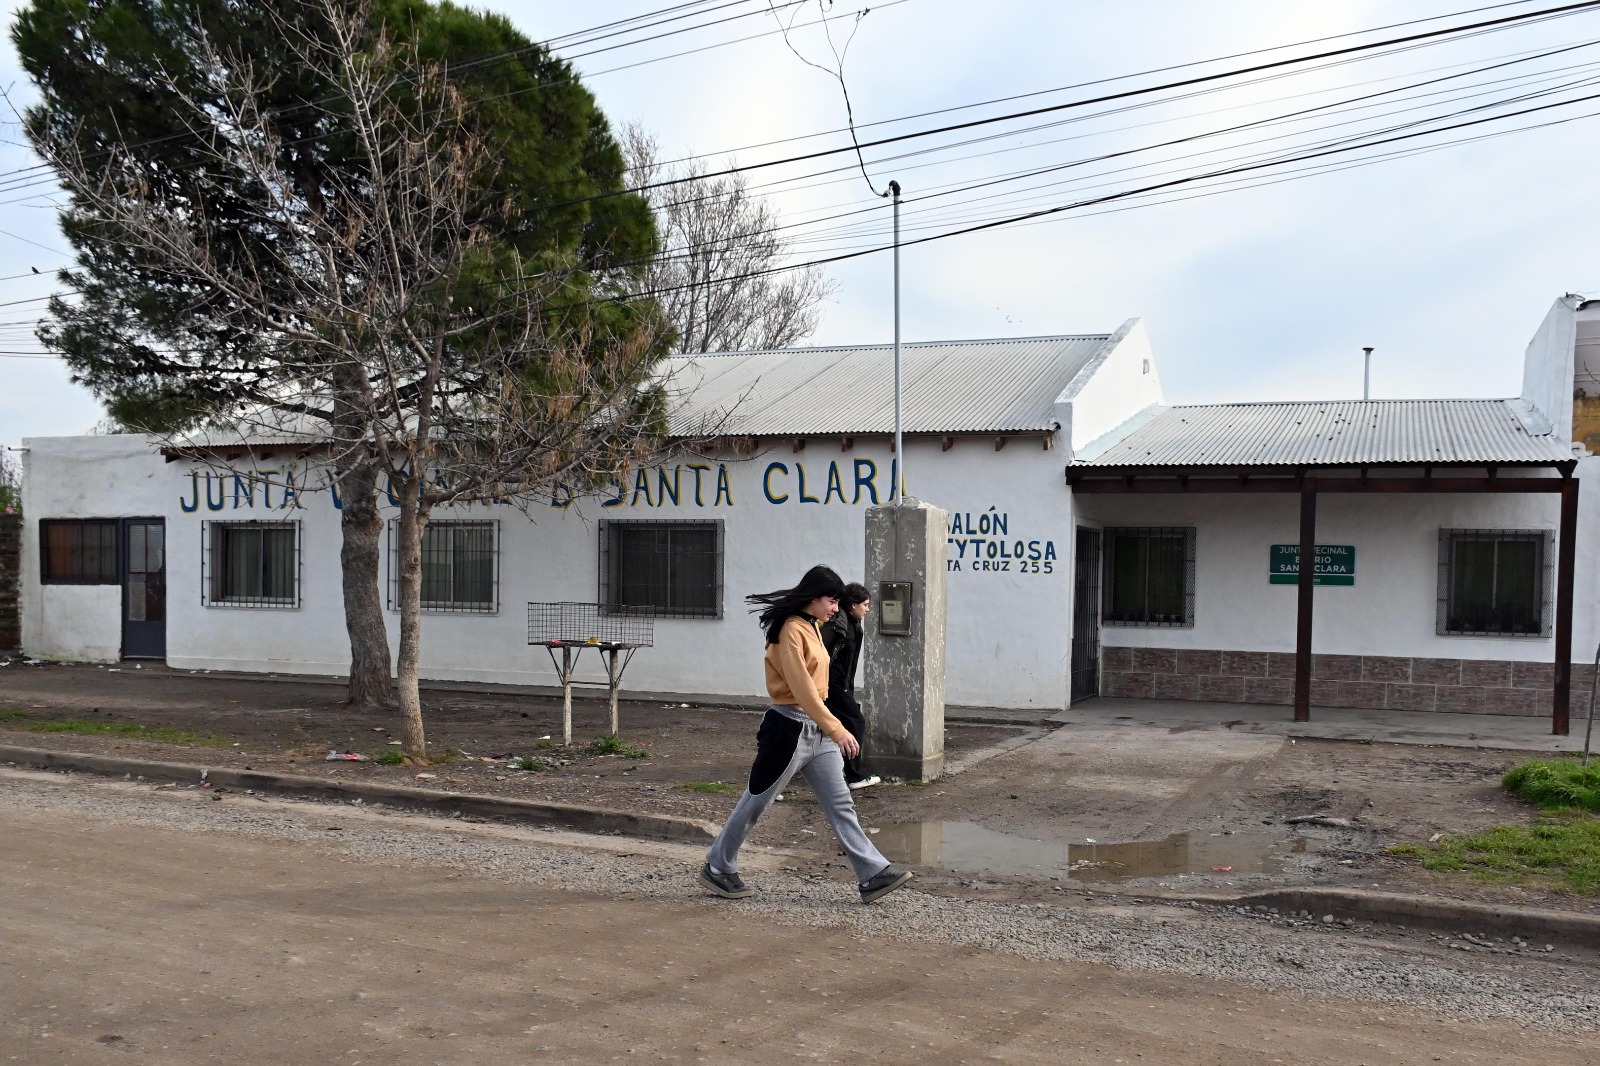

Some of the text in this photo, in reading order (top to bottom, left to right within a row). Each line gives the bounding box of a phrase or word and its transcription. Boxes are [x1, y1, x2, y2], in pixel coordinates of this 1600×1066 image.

[179, 468, 304, 513] JUNTA
[762, 457, 906, 505] CLARA
[947, 505, 1008, 535] ALÓN
[1279, 546, 1301, 554] JUNT
[972, 560, 1011, 572] CRUZ
[1020, 561, 1053, 574] 255
[1280, 564, 1346, 573] SAN CLARA
